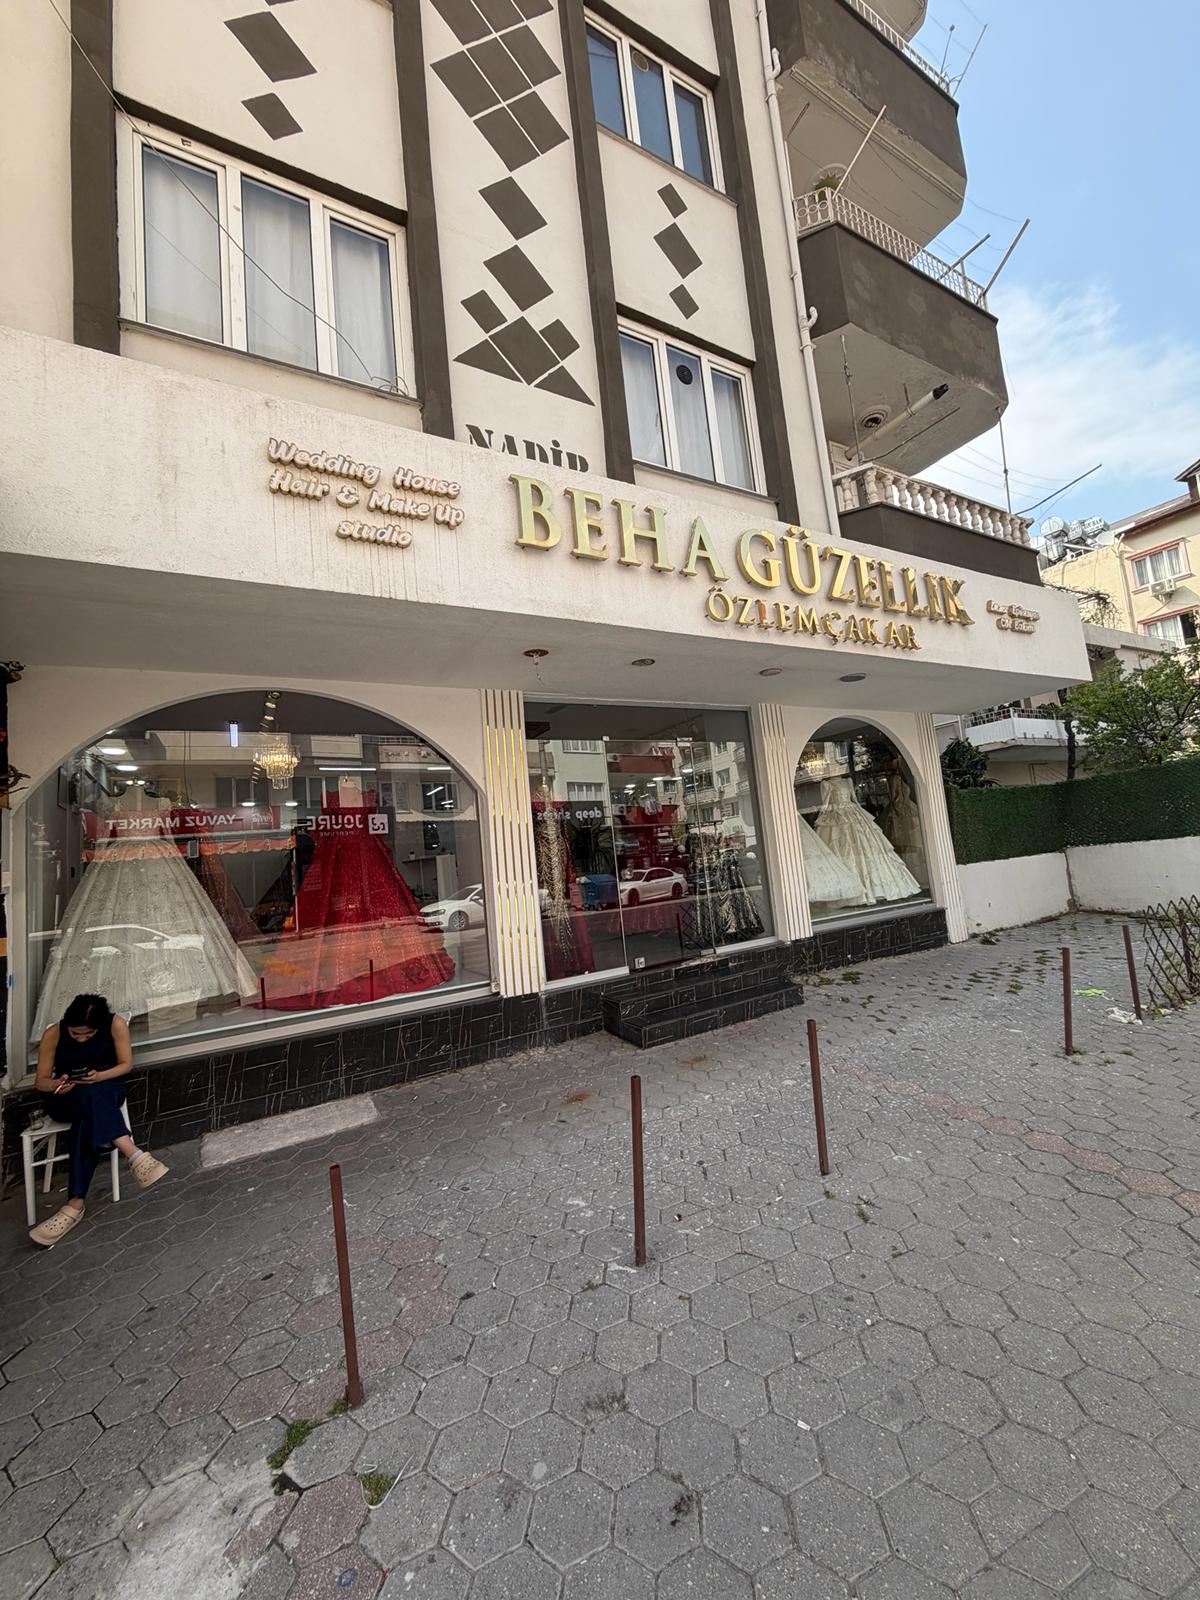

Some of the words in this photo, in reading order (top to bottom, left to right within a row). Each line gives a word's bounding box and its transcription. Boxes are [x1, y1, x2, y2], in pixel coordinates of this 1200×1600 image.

[268, 437, 381, 488] Wedding
[393, 466, 461, 499] House
[269, 468, 330, 500] Hair
[336, 485, 359, 508] &
[367, 489, 431, 521] Make
[336, 519, 412, 549] studio
[508, 473, 729, 582] BEHA
